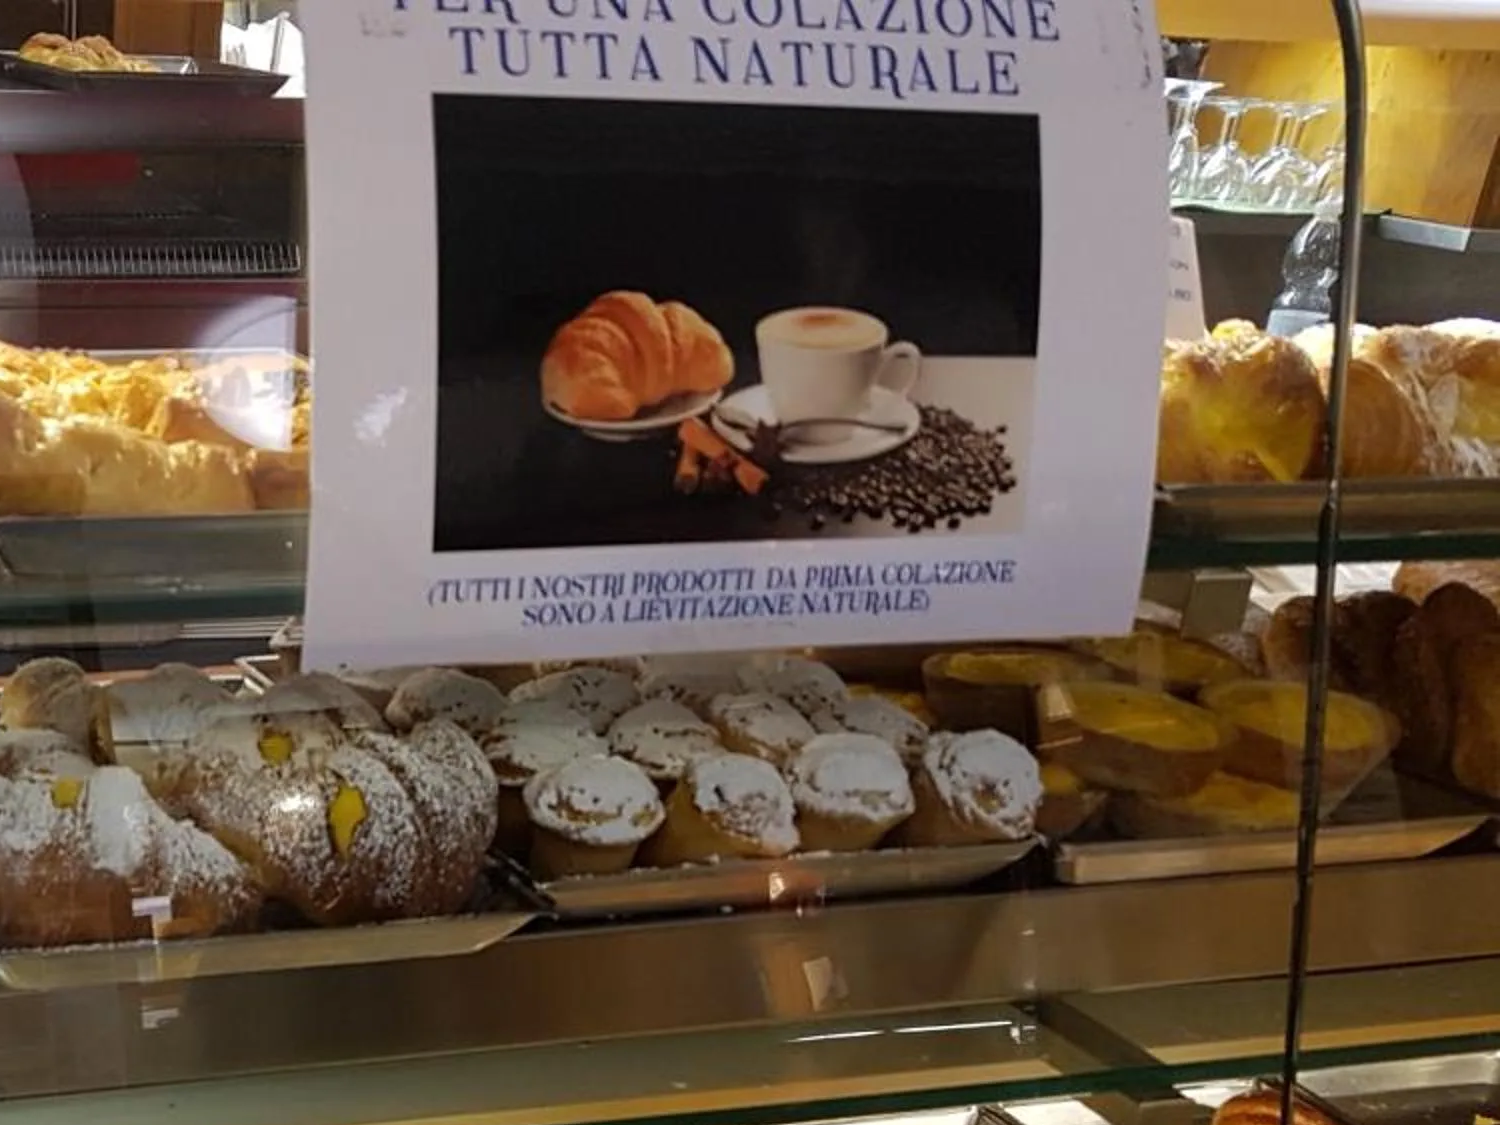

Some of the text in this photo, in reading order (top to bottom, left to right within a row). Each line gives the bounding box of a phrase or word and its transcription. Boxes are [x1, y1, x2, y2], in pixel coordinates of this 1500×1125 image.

[450, 27, 1019, 99] TUTTA NATURALE
[428, 577, 511, 607] (TUTTI
[532, 572, 625, 600] NOSTRI
[632, 567, 755, 597] PRODOTTI
[766, 568, 797, 590] DA
[804, 564, 875, 592] PRIMA
[881, 559, 1017, 587] COLAZIONE
[521, 588, 931, 628] SONO A LIEVITAZIONE NATURALE)
